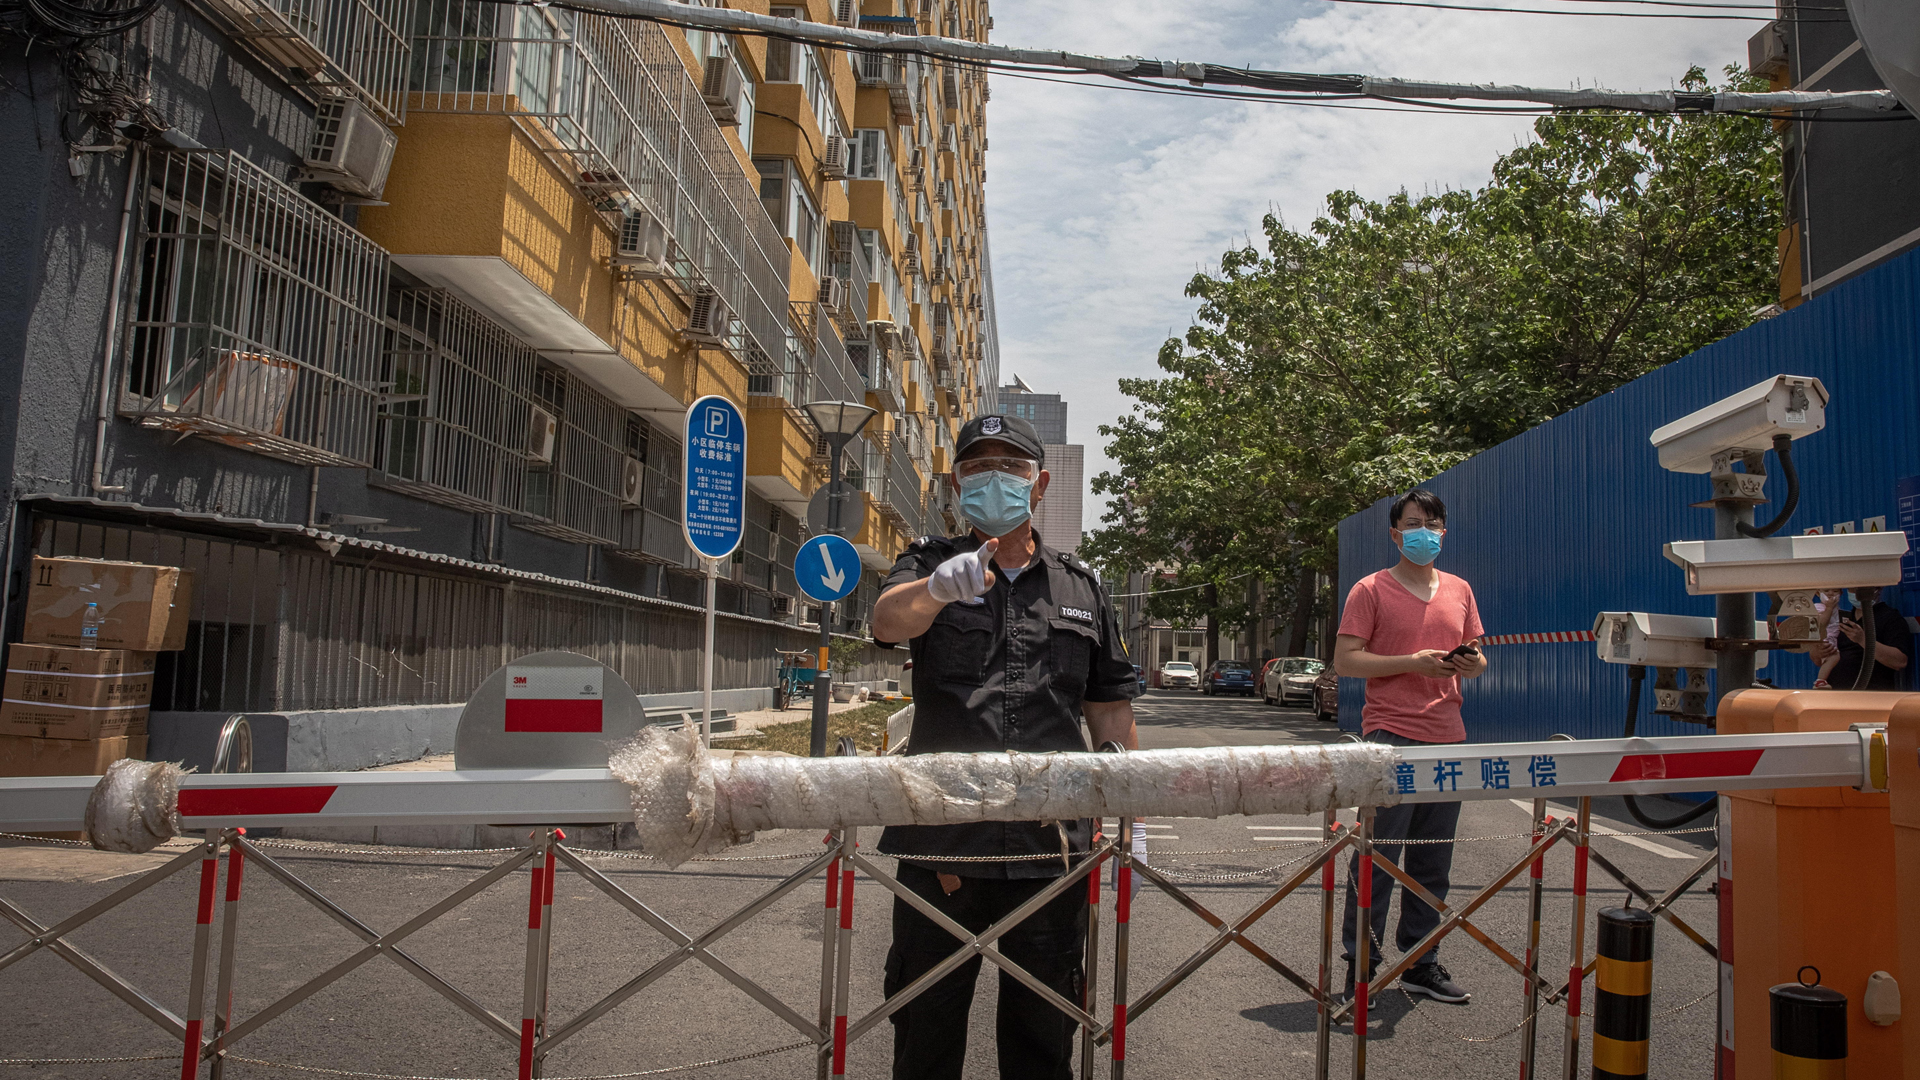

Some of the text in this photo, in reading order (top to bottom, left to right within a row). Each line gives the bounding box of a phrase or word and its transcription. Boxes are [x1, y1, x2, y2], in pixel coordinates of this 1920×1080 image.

[710, 410, 724, 432] P
[691, 436, 741, 453] 小区临停车辆
[699, 448, 732, 462] 收费标准
[1062, 607, 1093, 621] TQ0021
[514, 676, 527, 684] 3M
